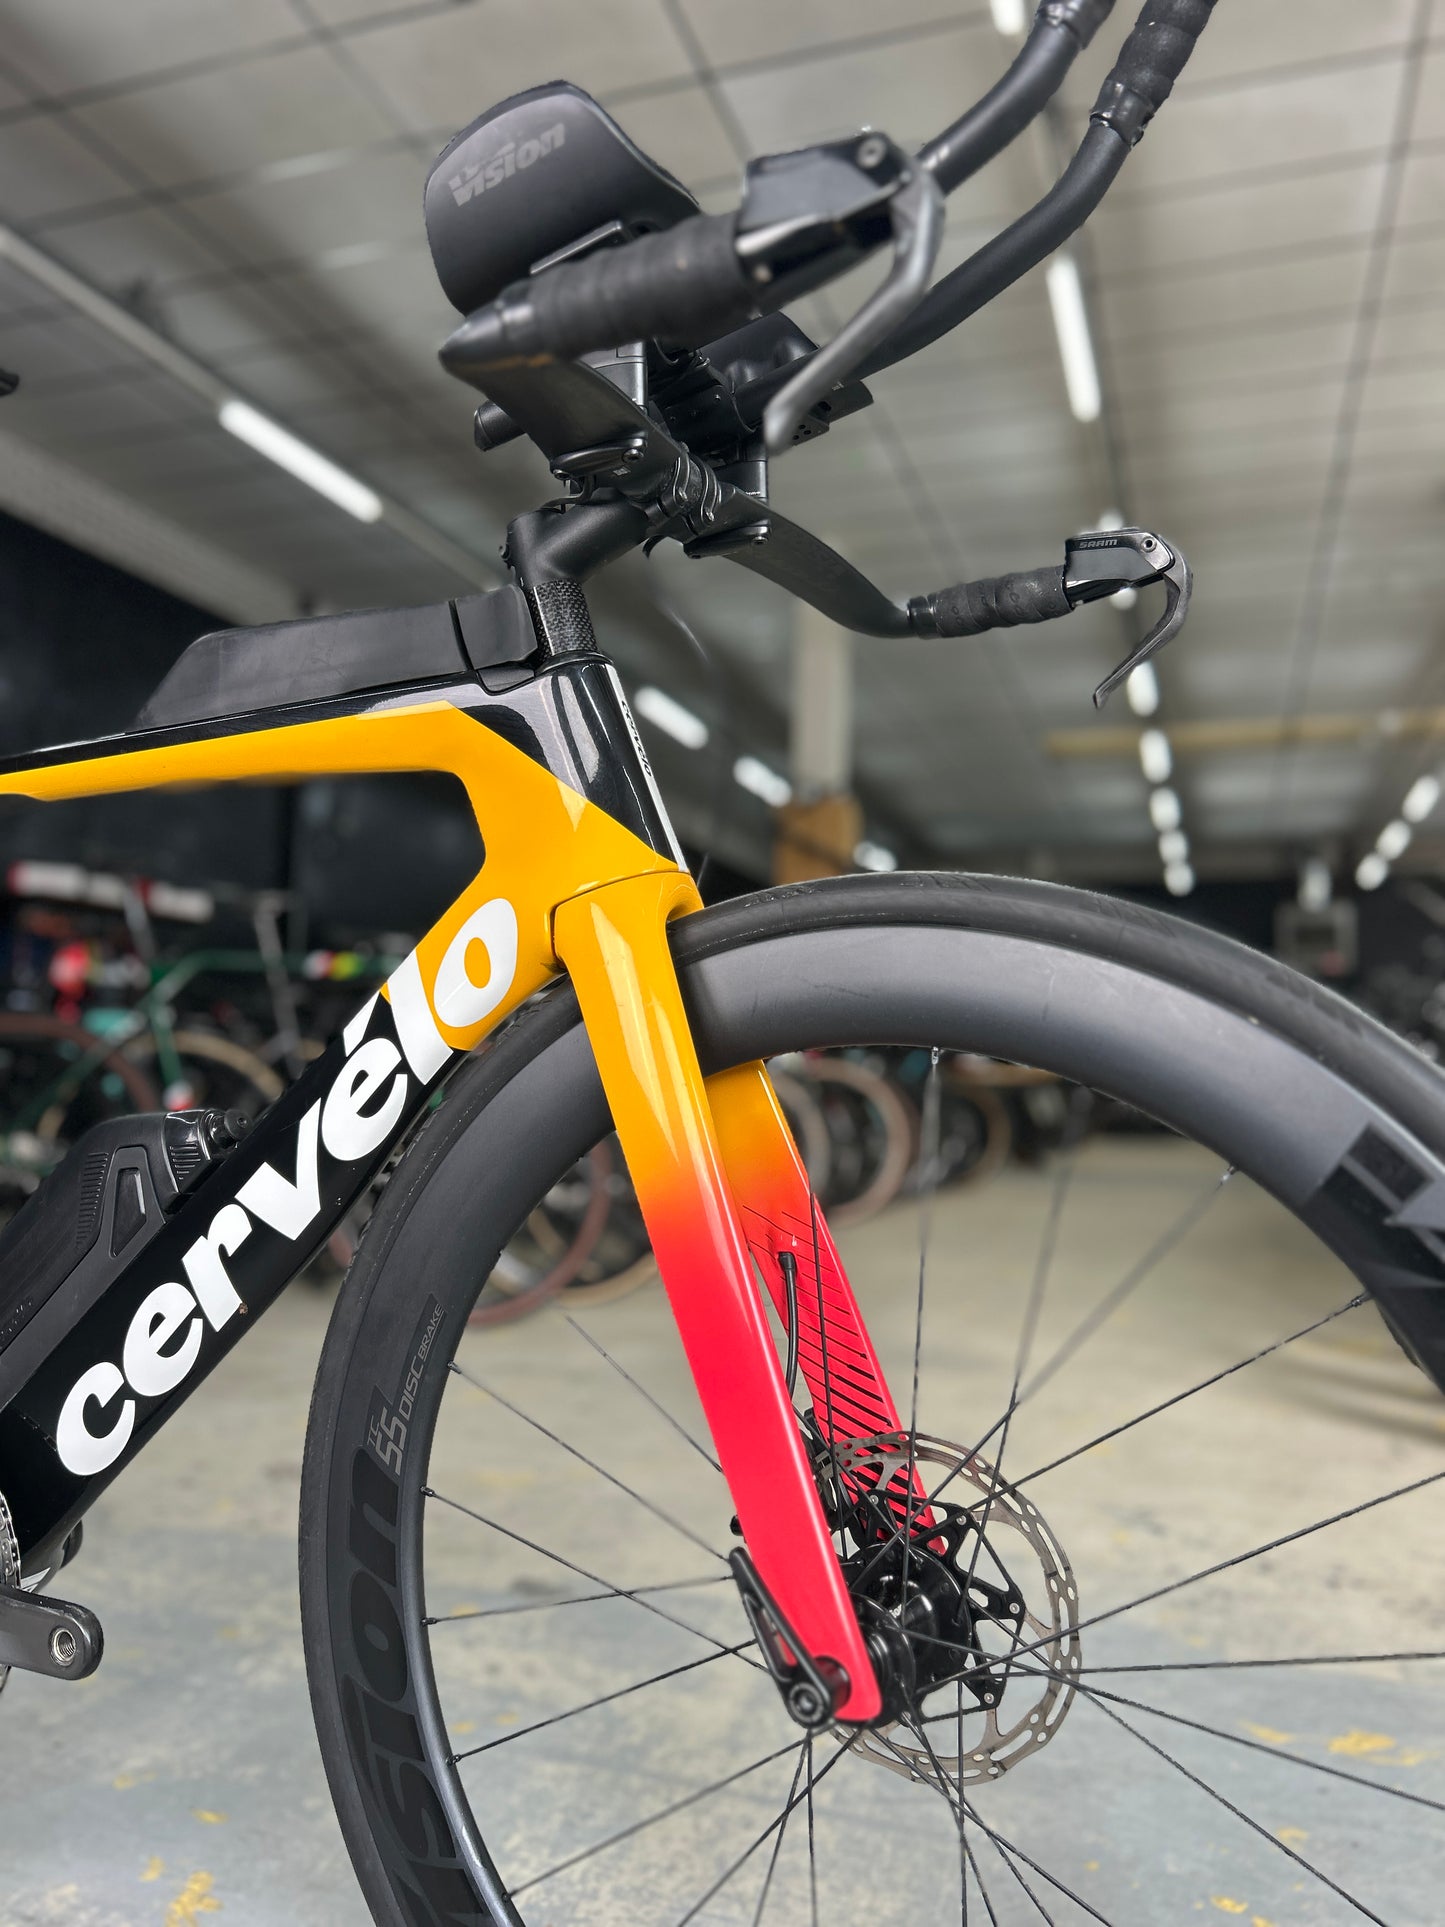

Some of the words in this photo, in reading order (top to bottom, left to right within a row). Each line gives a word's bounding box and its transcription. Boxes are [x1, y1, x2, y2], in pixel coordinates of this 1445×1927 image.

[449, 121, 566, 208] Vision
[1080, 539, 1118, 549] SRAM
[374, 1405, 408, 1477] 55
[398, 1355, 424, 1421] DISC
[417, 1302, 445, 1363] BRAKE
[366, 1414, 380, 1447] TC
